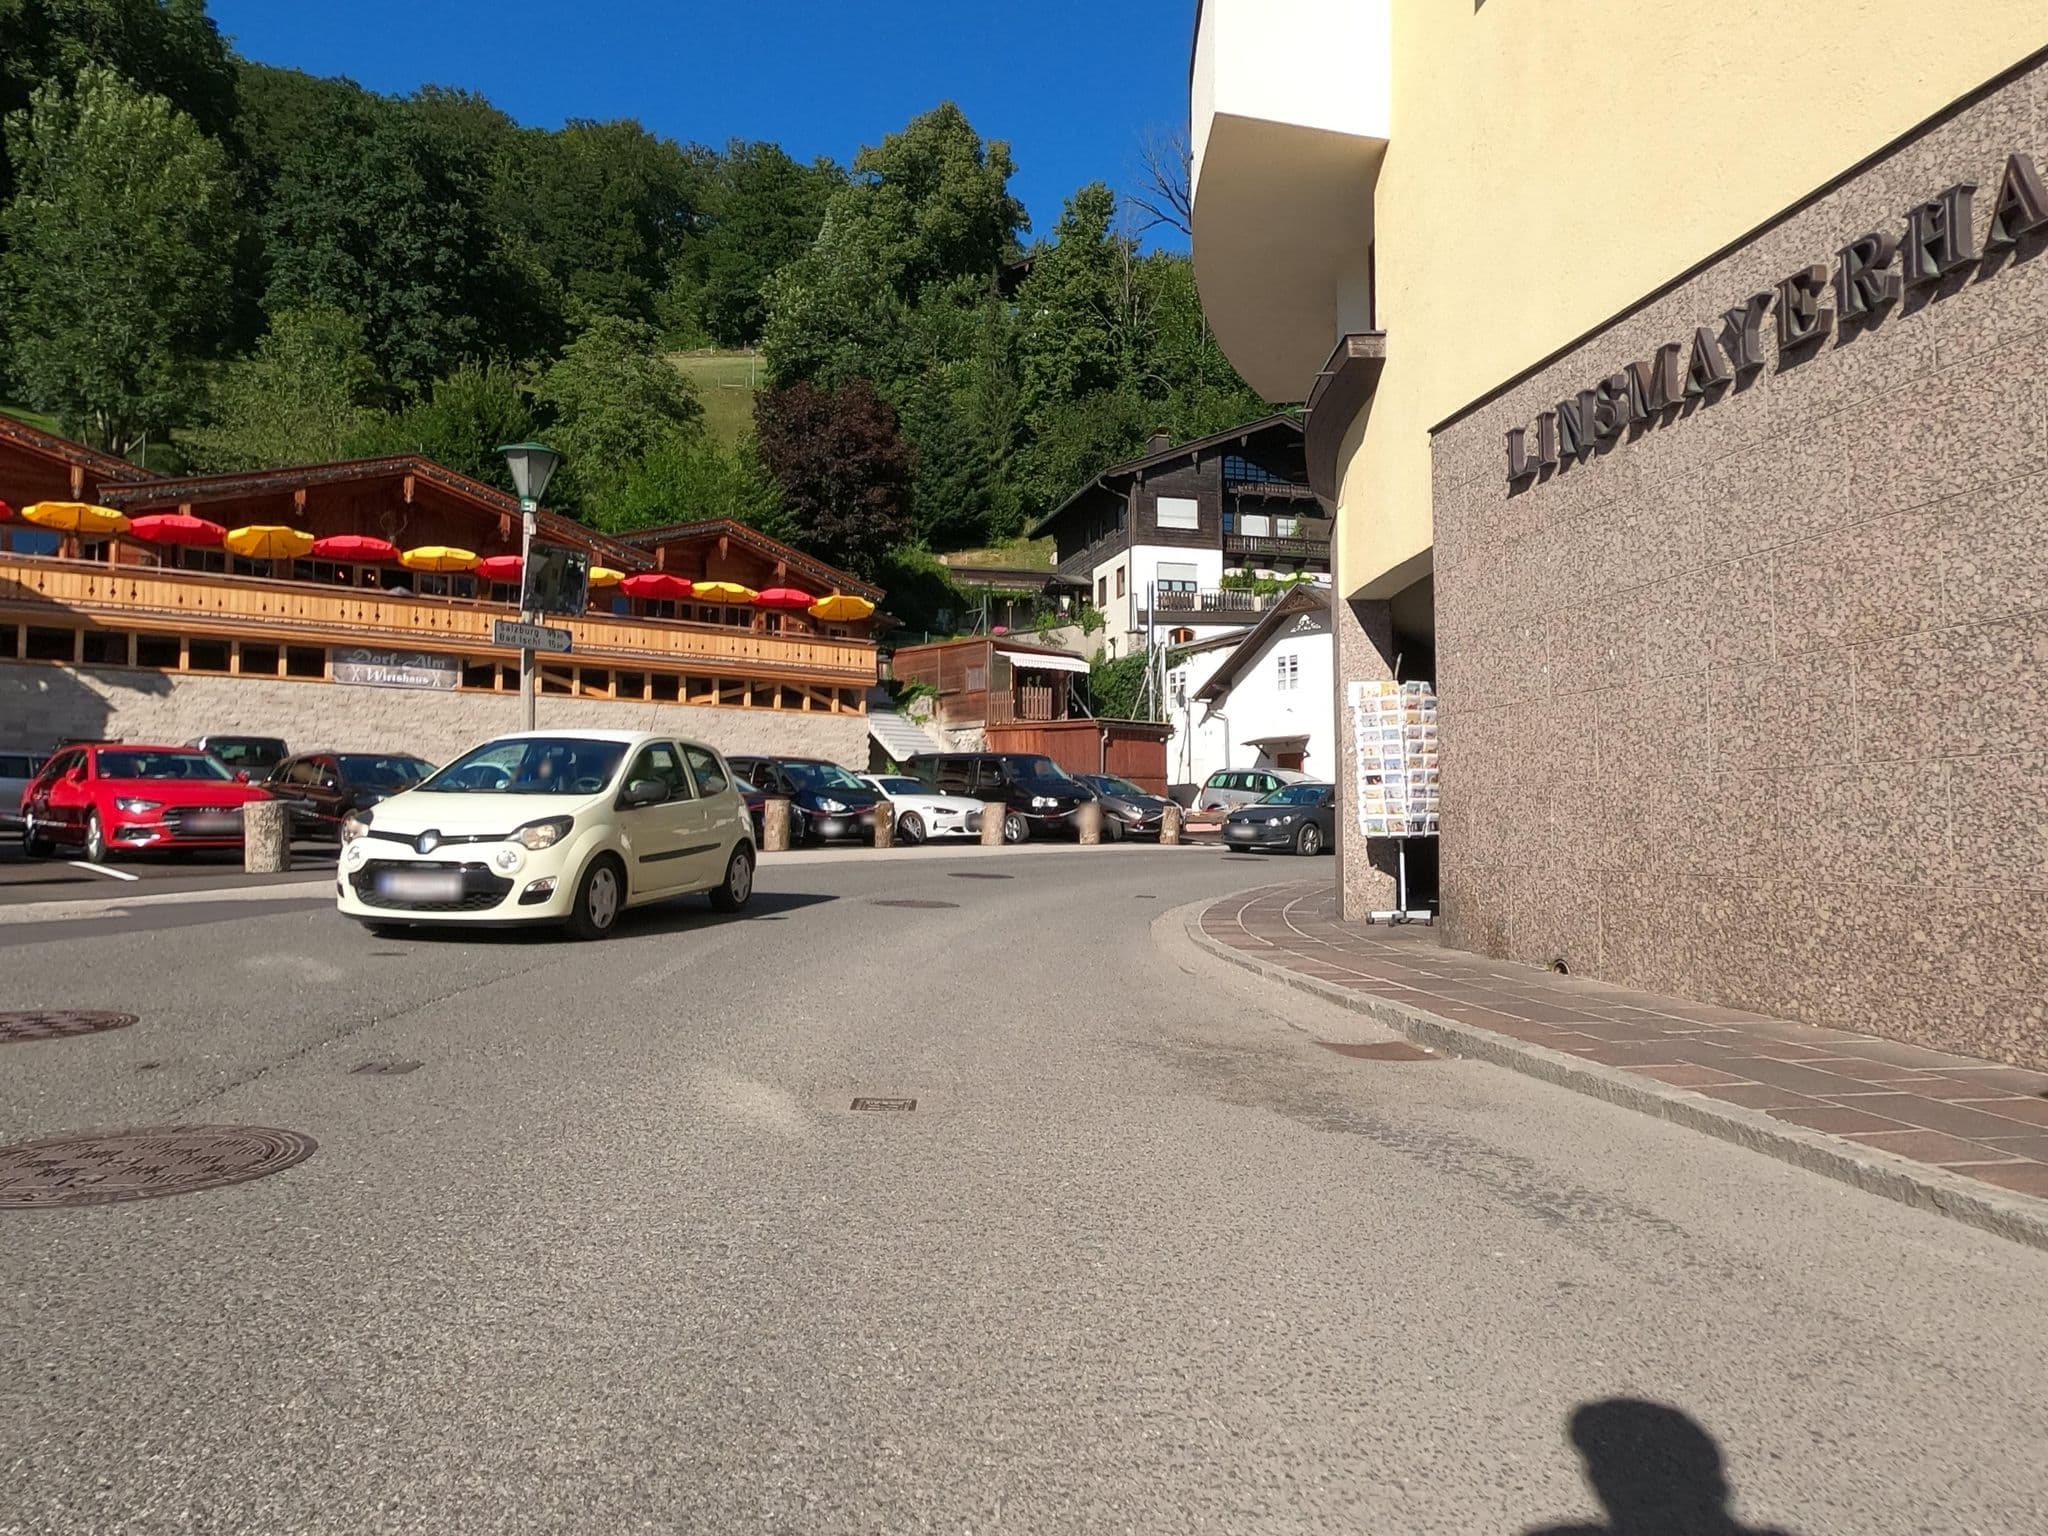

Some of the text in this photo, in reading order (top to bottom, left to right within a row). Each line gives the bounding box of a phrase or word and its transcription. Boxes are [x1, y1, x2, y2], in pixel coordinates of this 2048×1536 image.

[1506, 153, 2048, 483] LINSMAYERHA
[501, 623, 540, 638] Salzburg
[499, 632, 516, 642] Bad
[519, 635, 541, 647] Ischl
[366, 667, 430, 685] Wirtshaus
